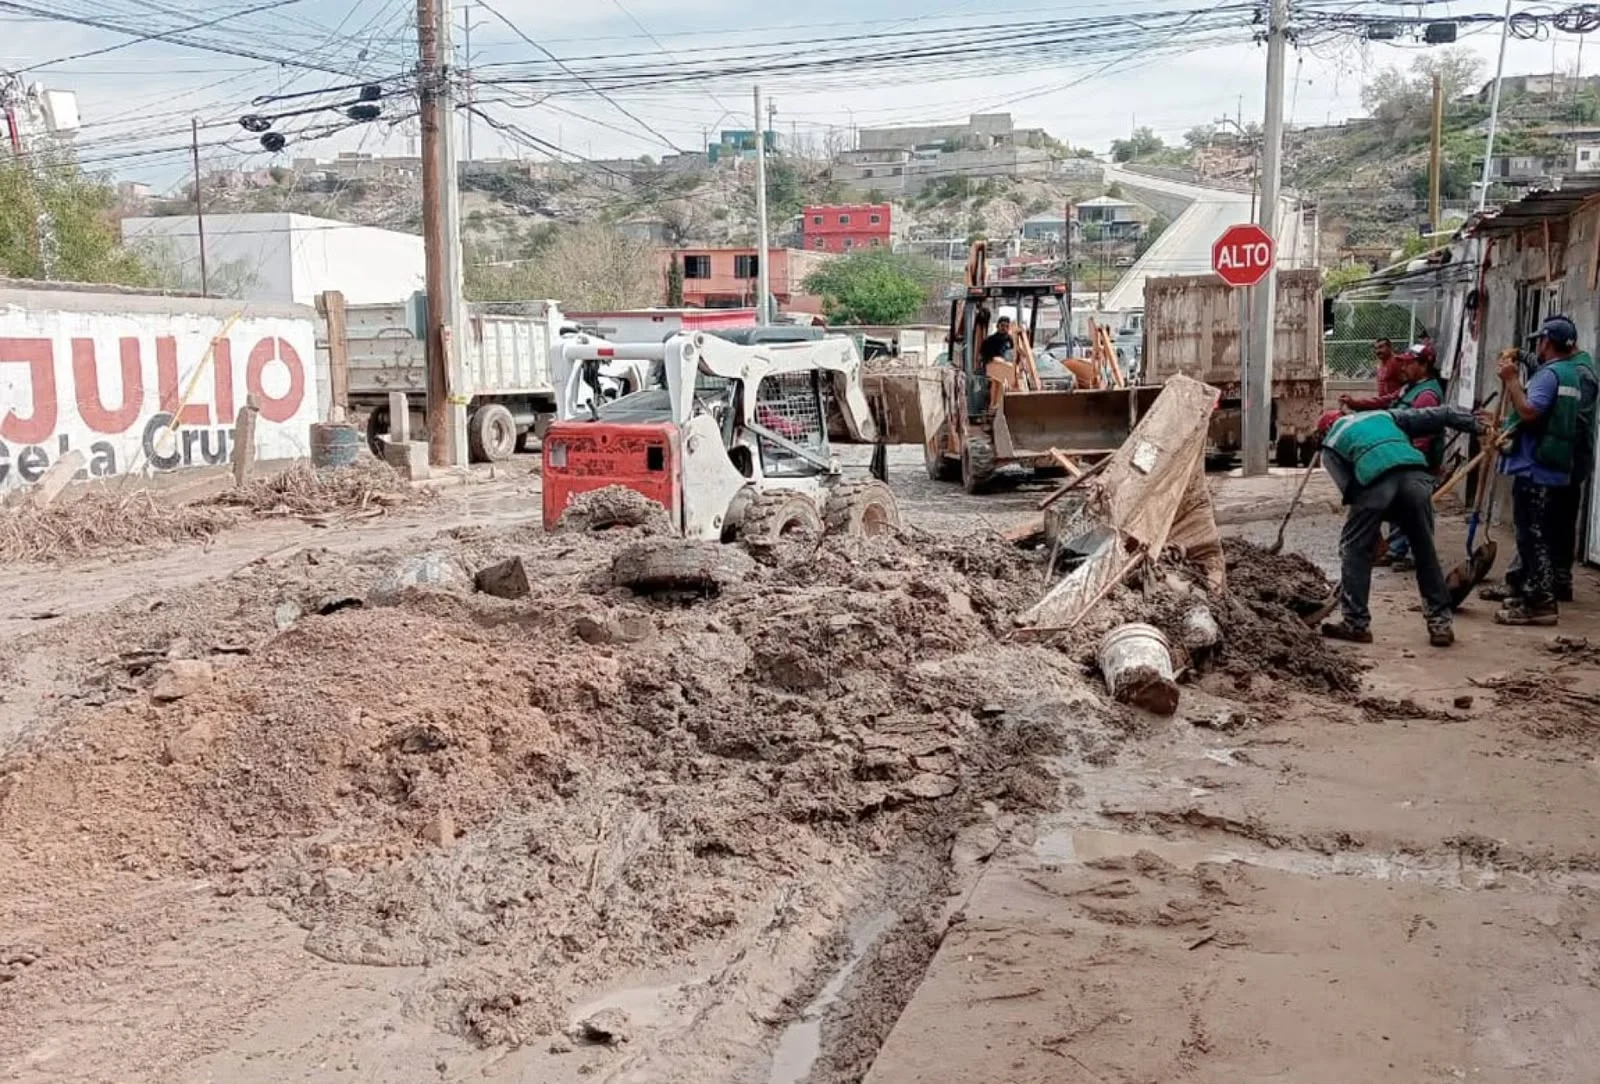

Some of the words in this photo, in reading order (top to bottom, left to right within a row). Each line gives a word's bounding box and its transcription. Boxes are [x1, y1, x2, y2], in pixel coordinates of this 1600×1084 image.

[1217, 242, 1270, 269] ALTO
[0, 336, 304, 444] JULIO
[142, 413, 237, 469] Cru
